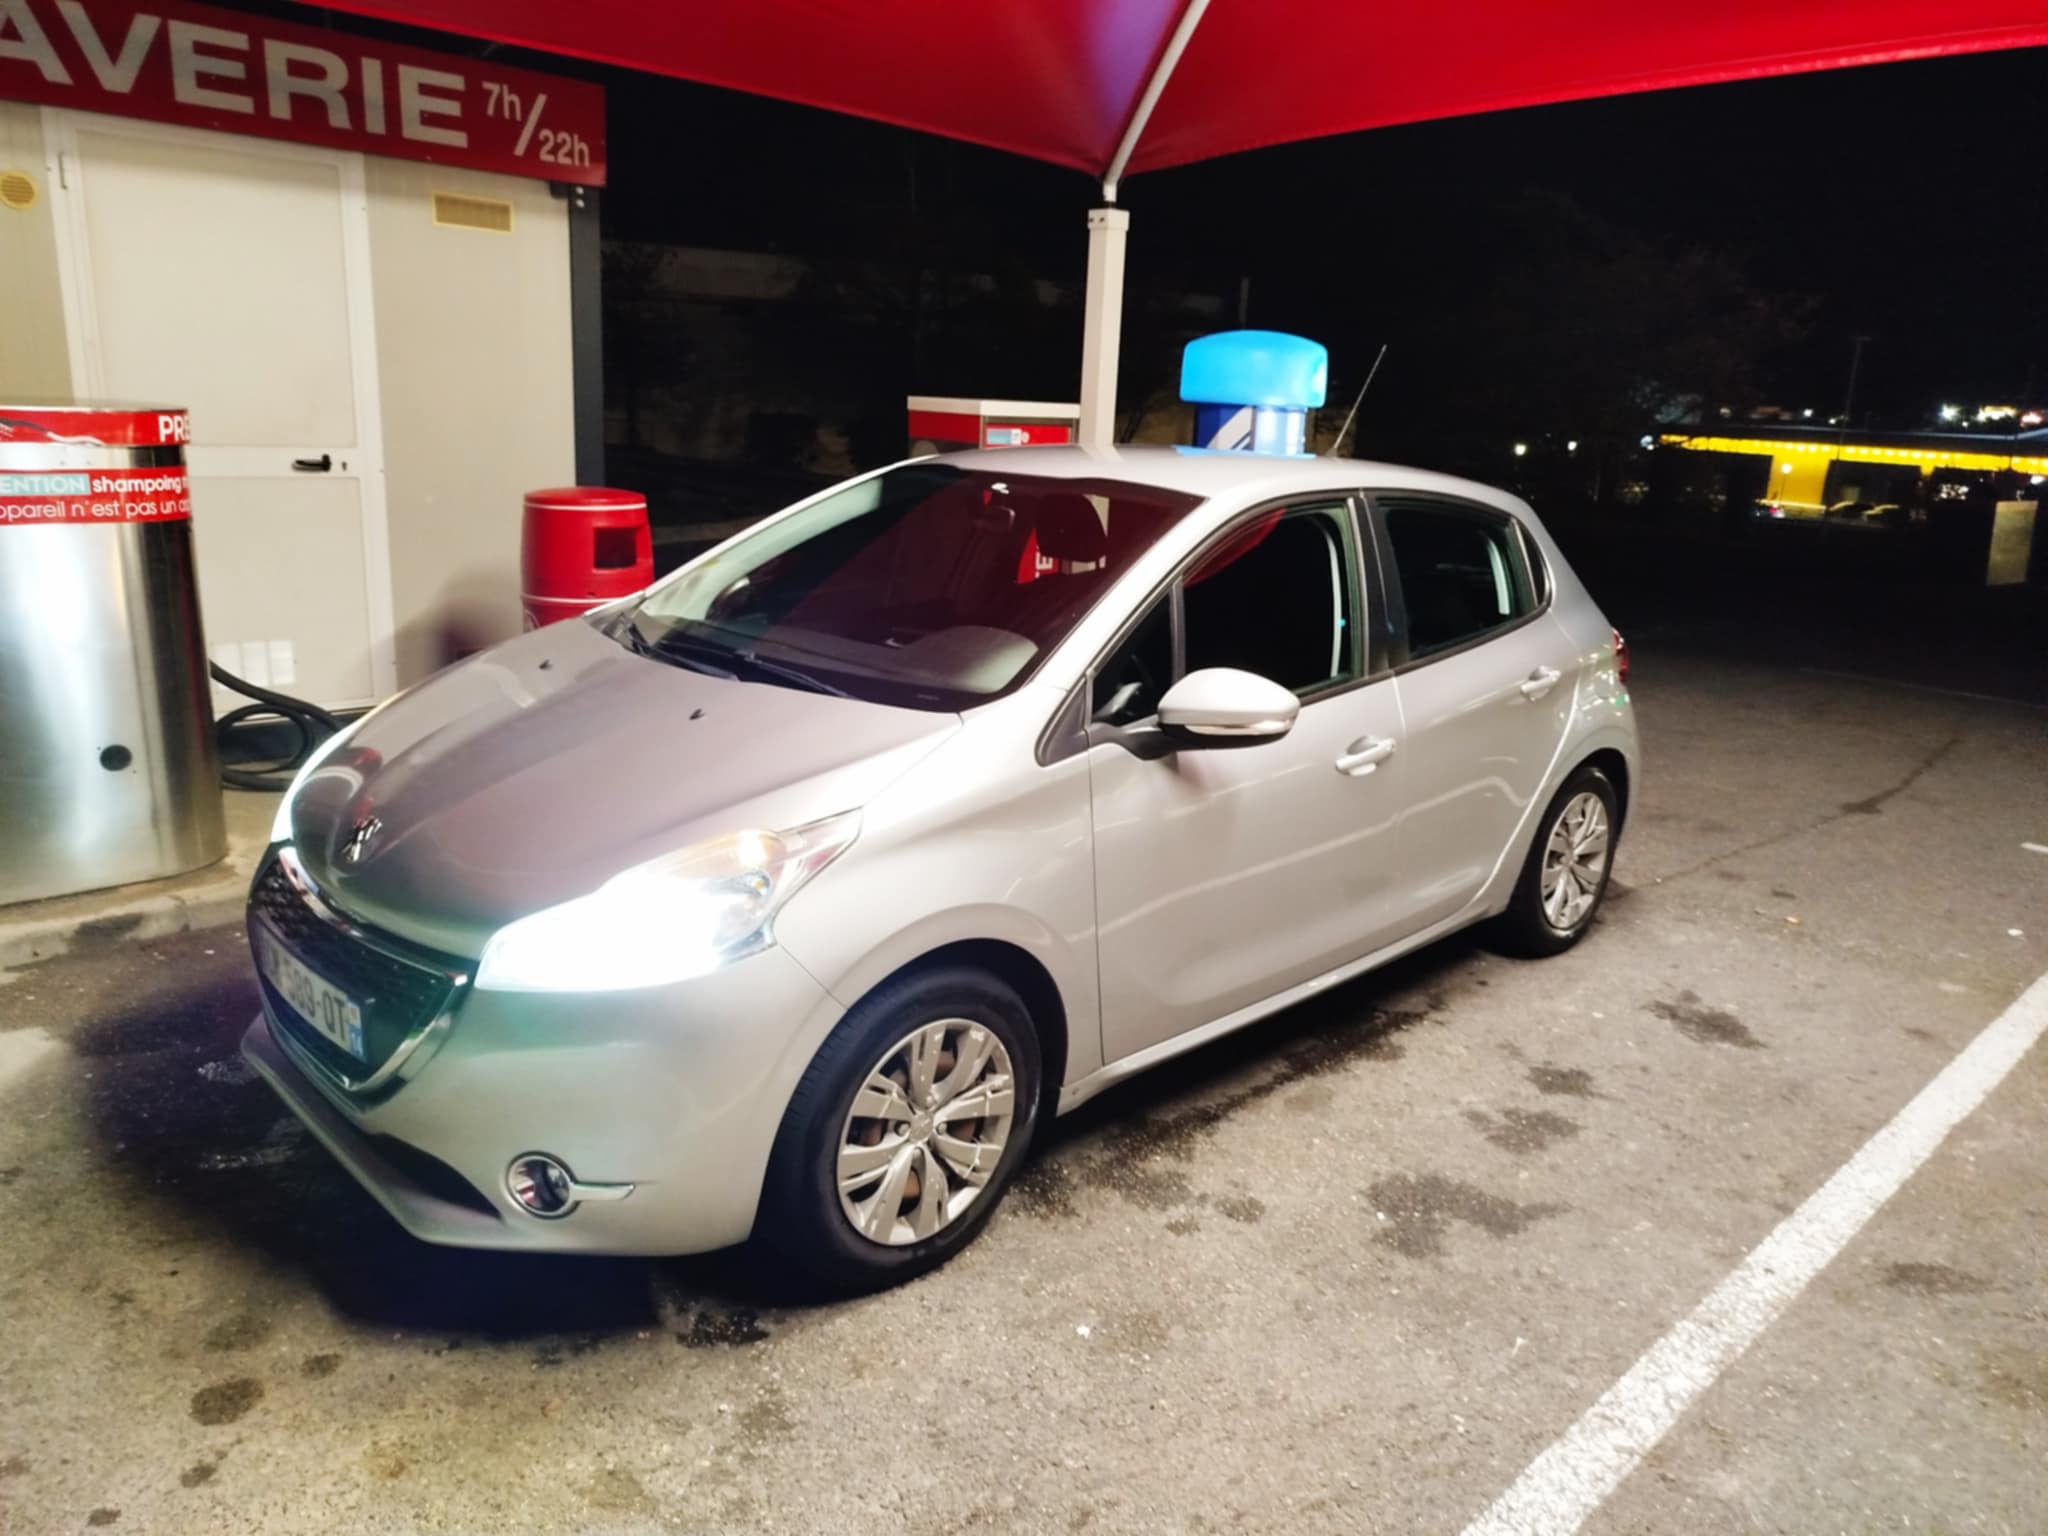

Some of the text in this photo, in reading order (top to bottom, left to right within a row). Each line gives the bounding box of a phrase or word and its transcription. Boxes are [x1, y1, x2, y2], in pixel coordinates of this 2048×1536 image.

[158, 414, 191, 442] PR
[92, 474, 182, 495] shampoing
[125, 502, 158, 519] pas
[160, 500, 177, 514] un
